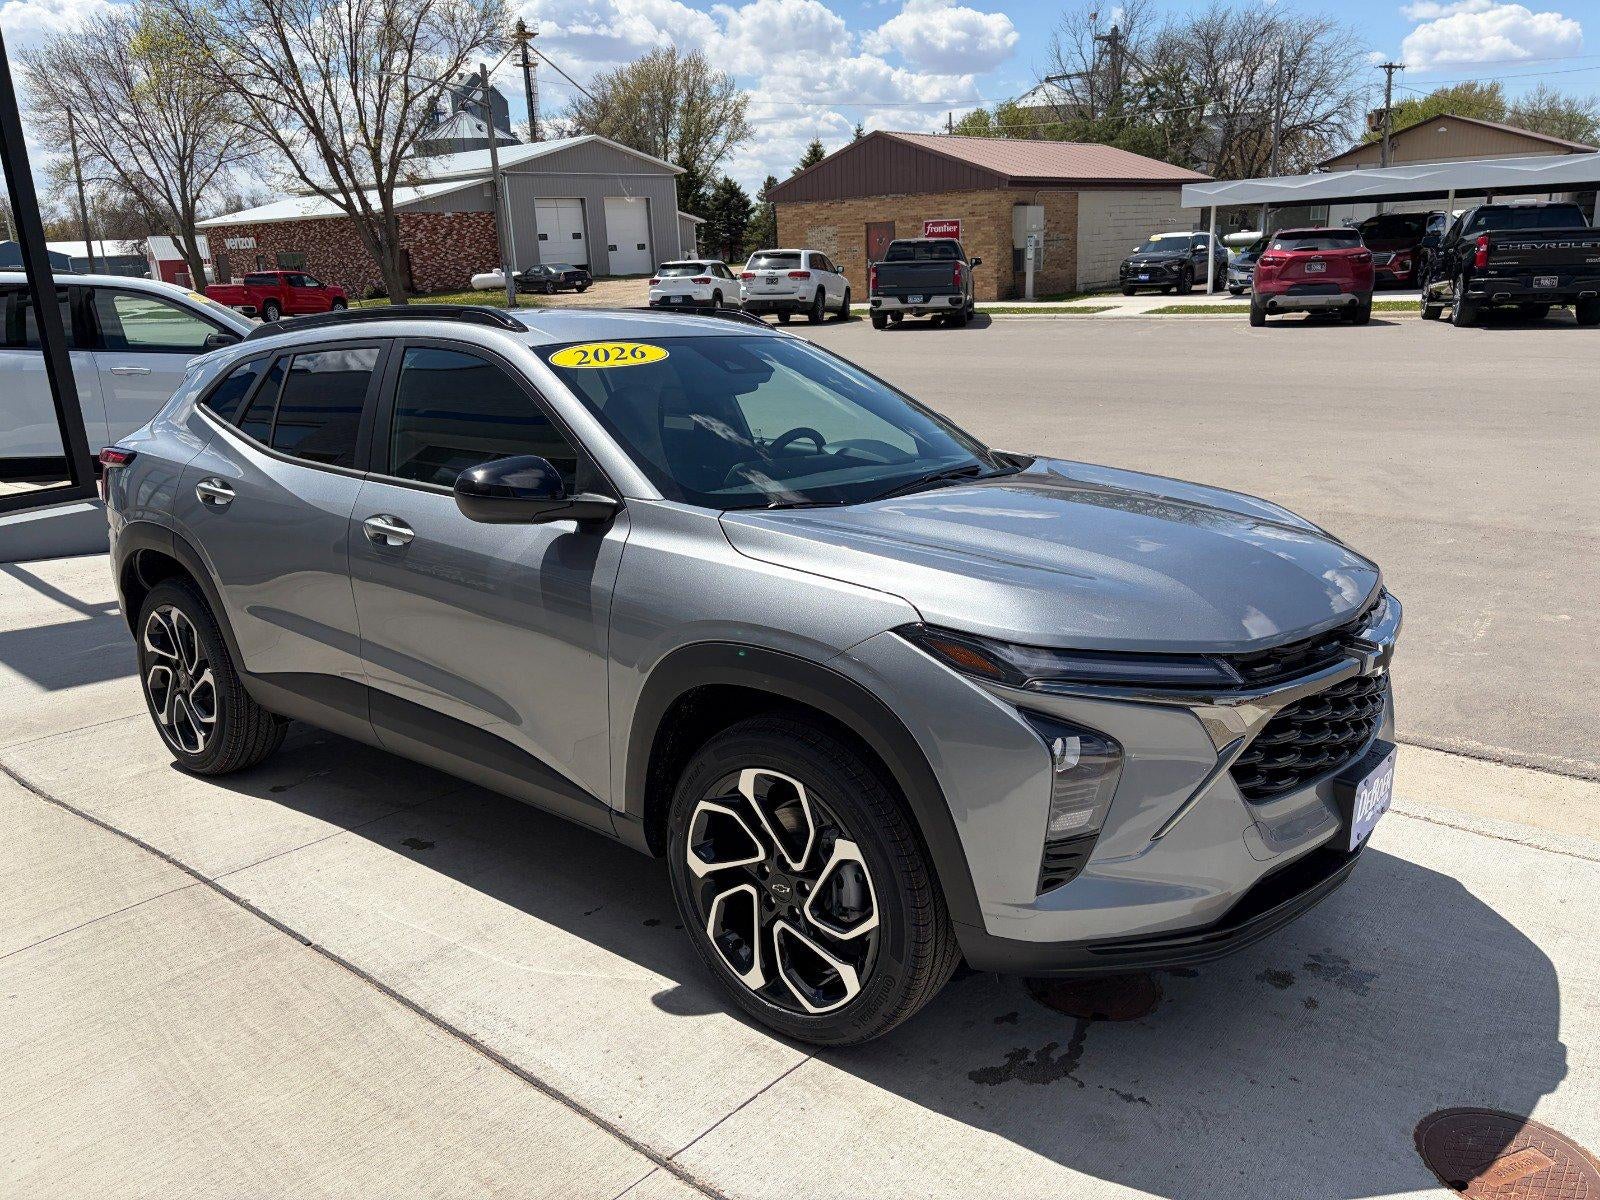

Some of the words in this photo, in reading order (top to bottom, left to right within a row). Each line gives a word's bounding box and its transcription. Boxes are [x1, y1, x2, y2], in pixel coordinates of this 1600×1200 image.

[925, 222, 958, 236] frontier
[224, 235, 257, 250] verizon
[573, 346, 647, 365] 2026
